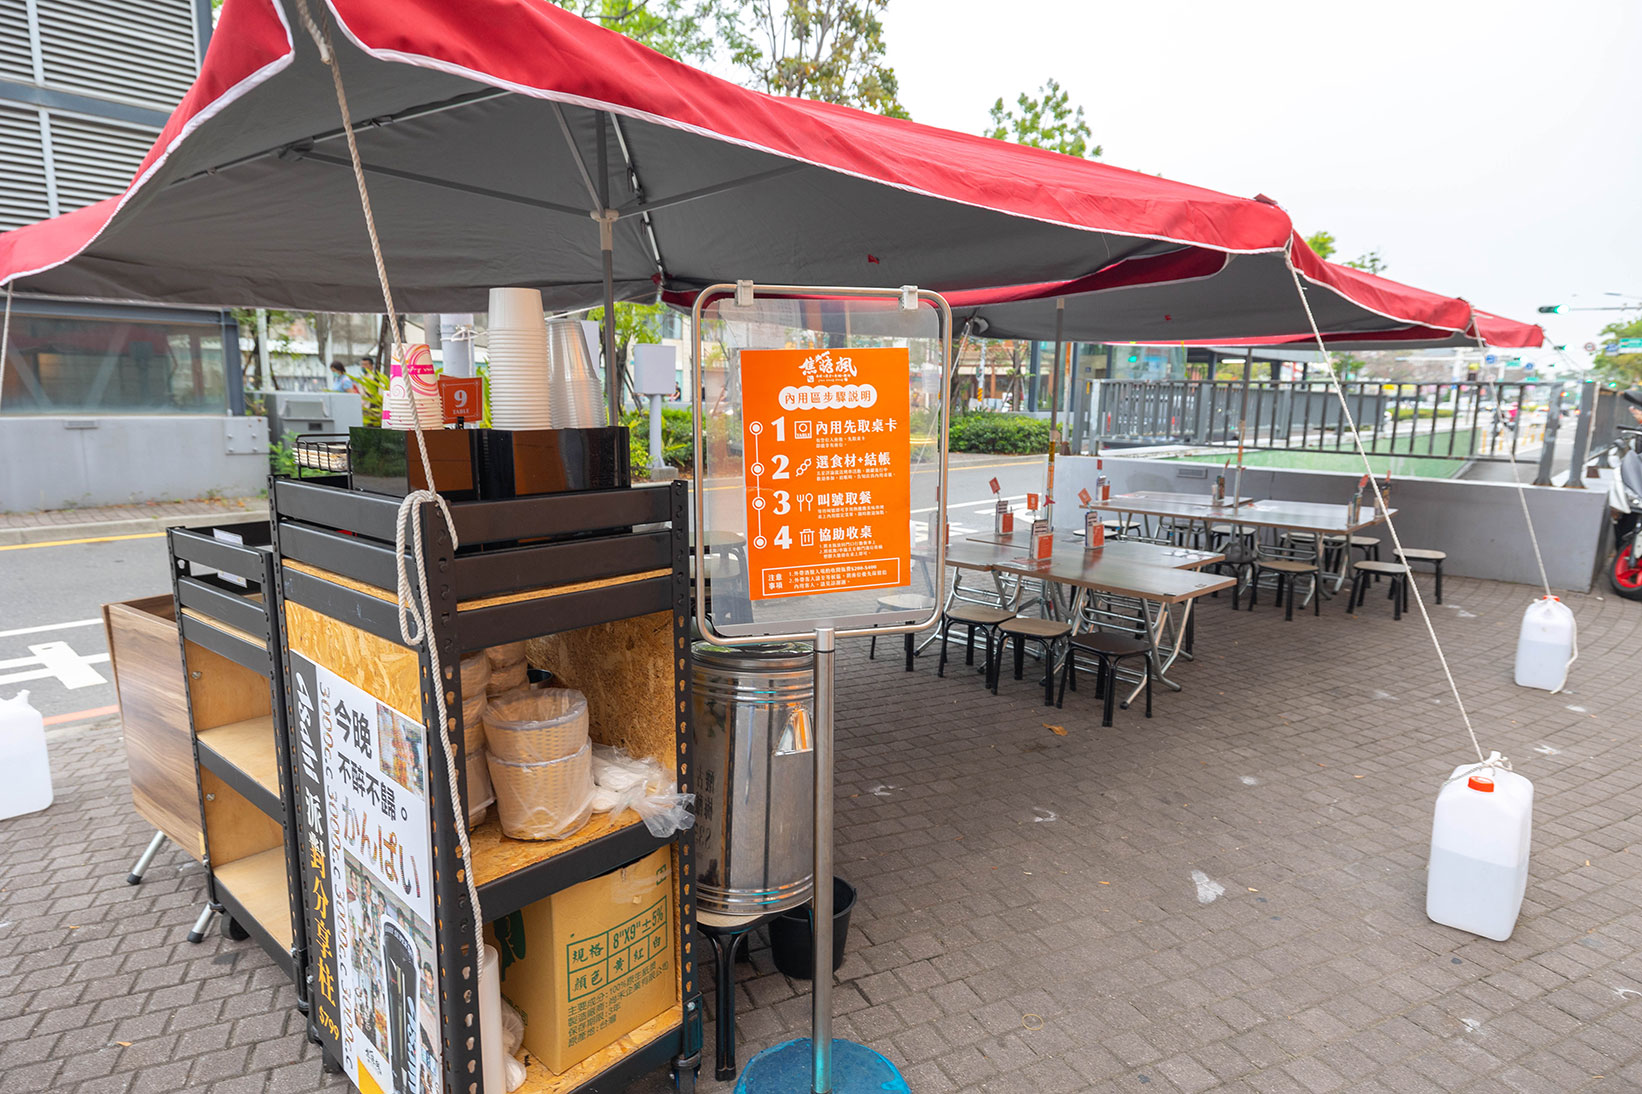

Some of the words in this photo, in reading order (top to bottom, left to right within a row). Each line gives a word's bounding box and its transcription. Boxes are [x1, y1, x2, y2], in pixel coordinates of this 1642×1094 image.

[454, 390, 467, 408] 9
[771, 416, 785, 442] 1
[816, 418, 898, 435] 內用先取桌卡
[771, 454, 789, 479] 2
[772, 490, 791, 515] 3
[817, 490, 872, 507] 叫號取餐
[774, 525, 793, 549] 4
[819, 525, 873, 542] 協助收桌
[768, 573, 782, 582] 注意
[768, 582, 783, 590] 事項
[295, 672, 320, 785] Asahi
[333, 699, 373, 760] 今晚
[341, 796, 421, 898] かんぱい
[305, 786, 336, 1008] 派對分享柱
[572, 943, 604, 964] 規格
[613, 957, 625, 974] 黃
[633, 947, 645, 963] 紅
[318, 1005, 340, 1041] $799
